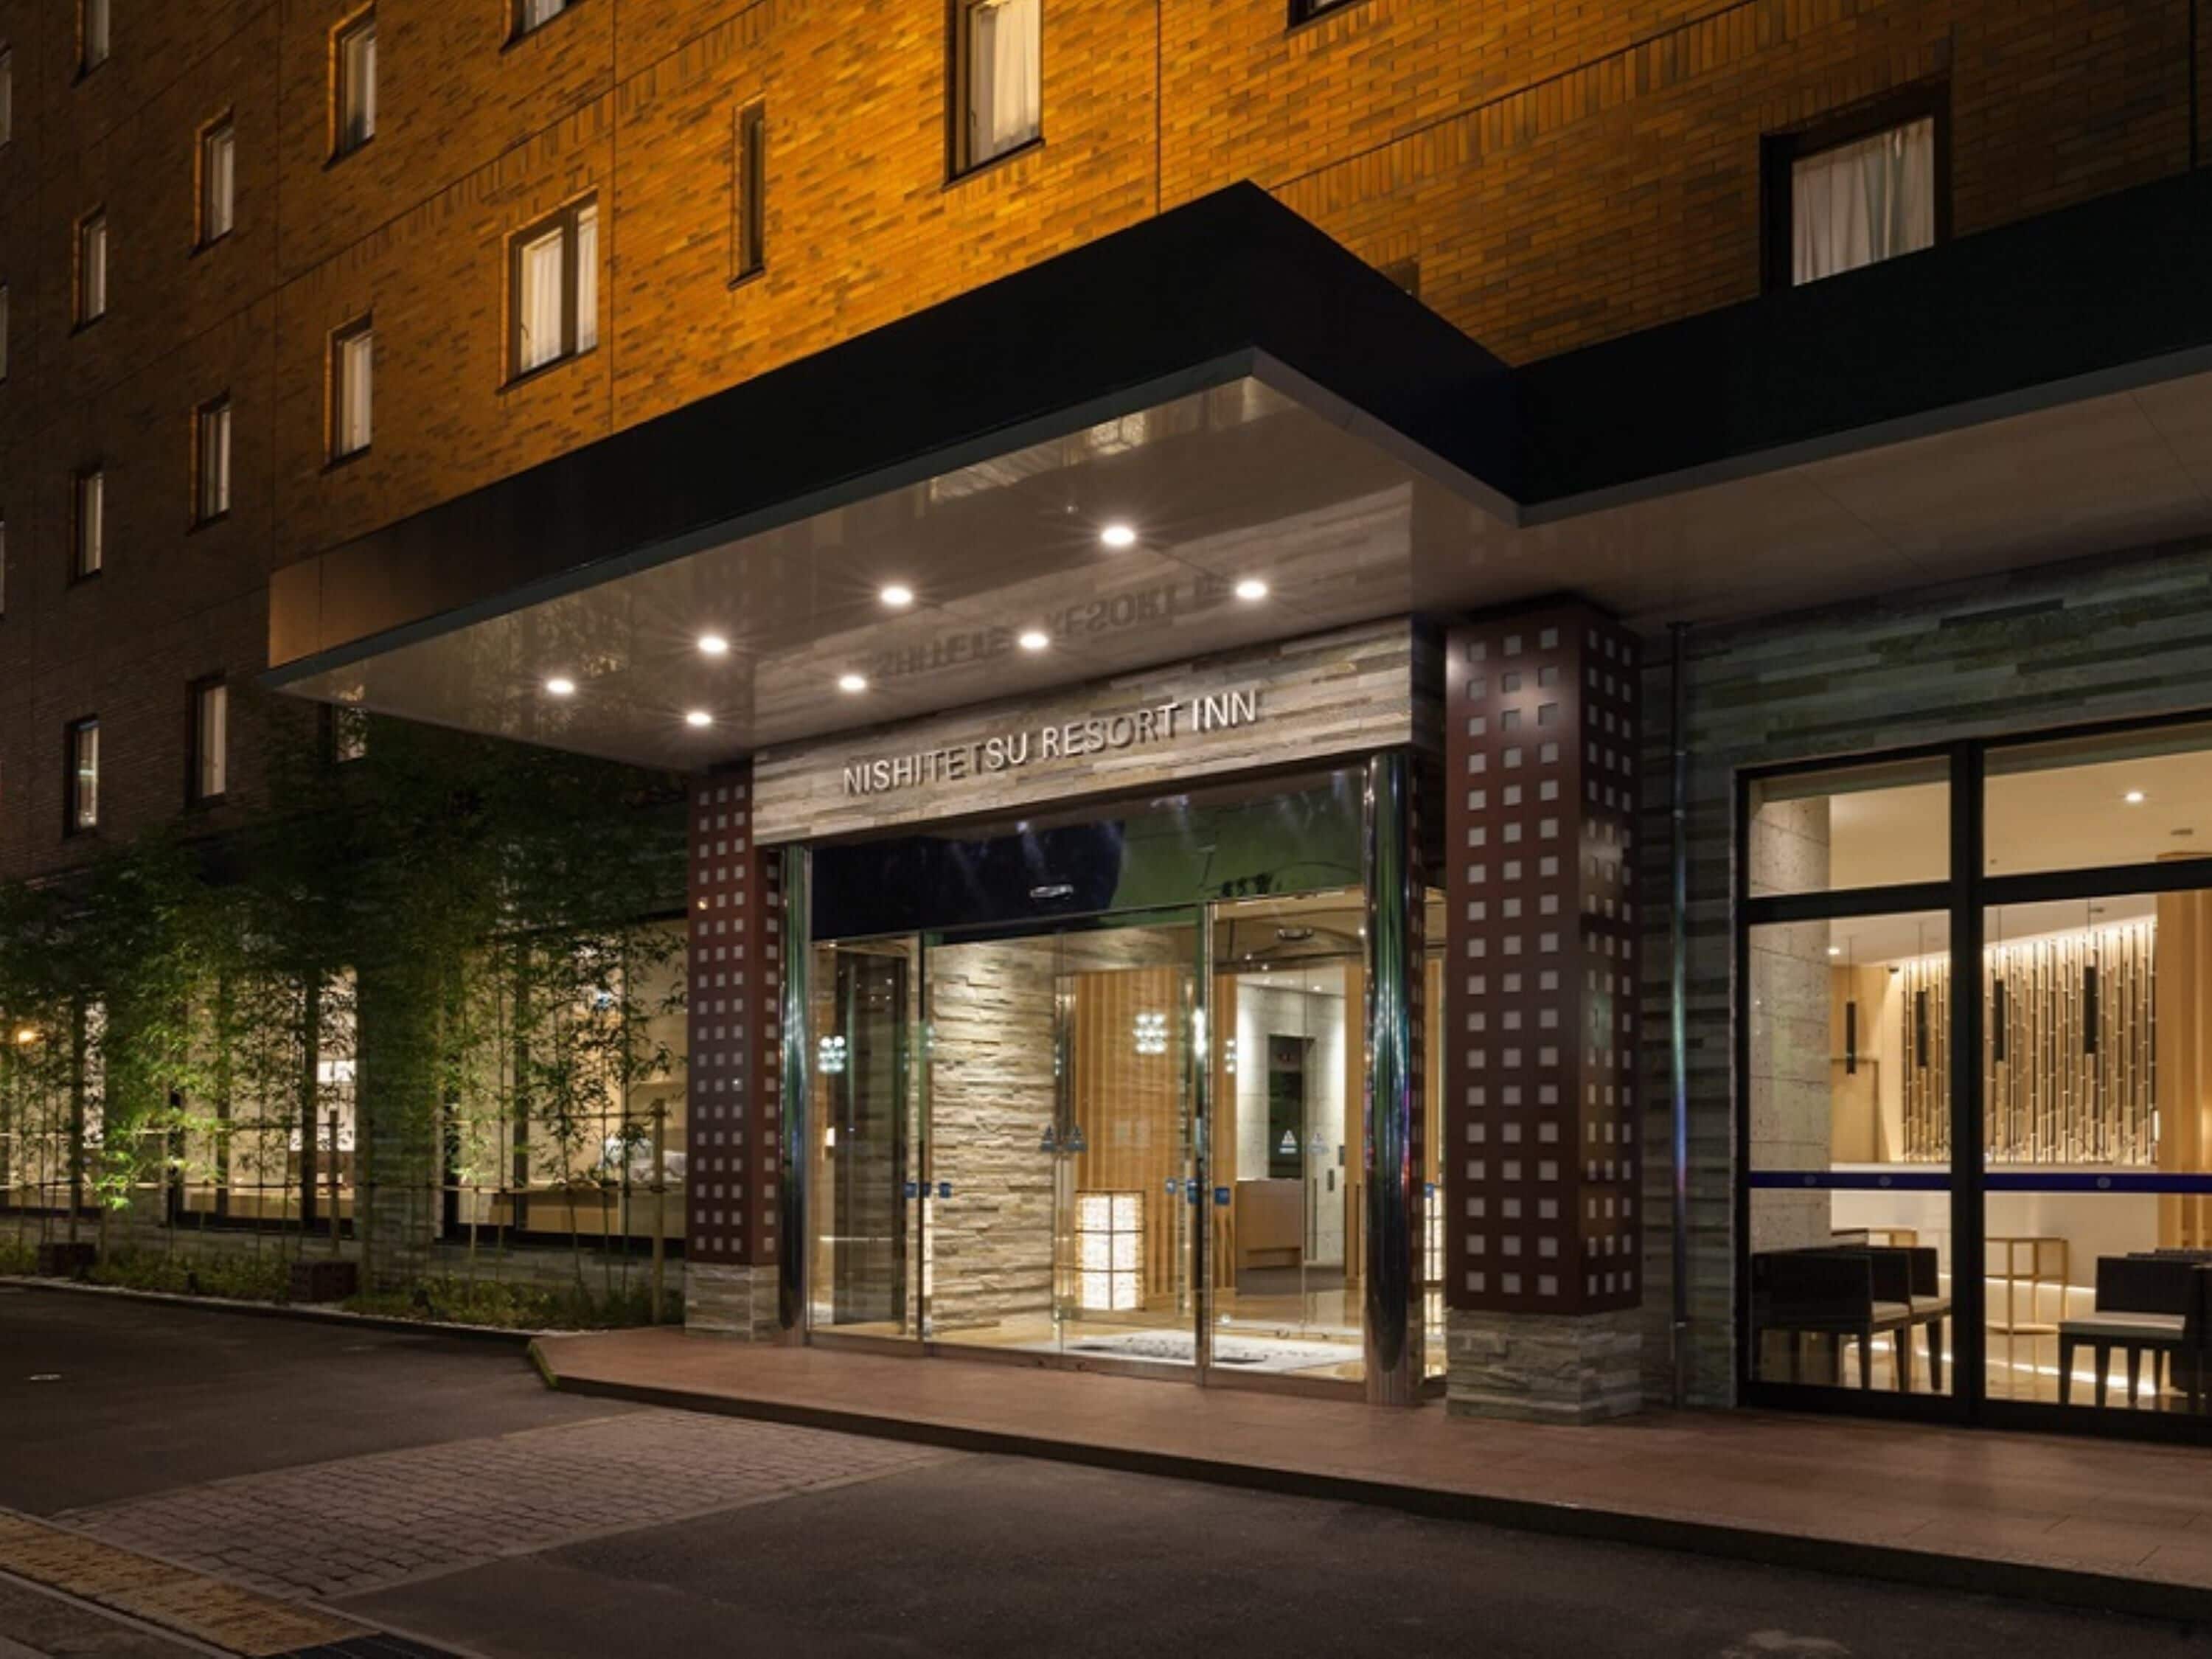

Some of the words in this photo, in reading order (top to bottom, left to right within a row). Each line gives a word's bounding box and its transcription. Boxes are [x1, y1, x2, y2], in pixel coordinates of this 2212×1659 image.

[843, 731, 1028, 796] NISHITETSU
[1042, 702, 1181, 759] RESORT
[1191, 689, 1258, 732] INN
